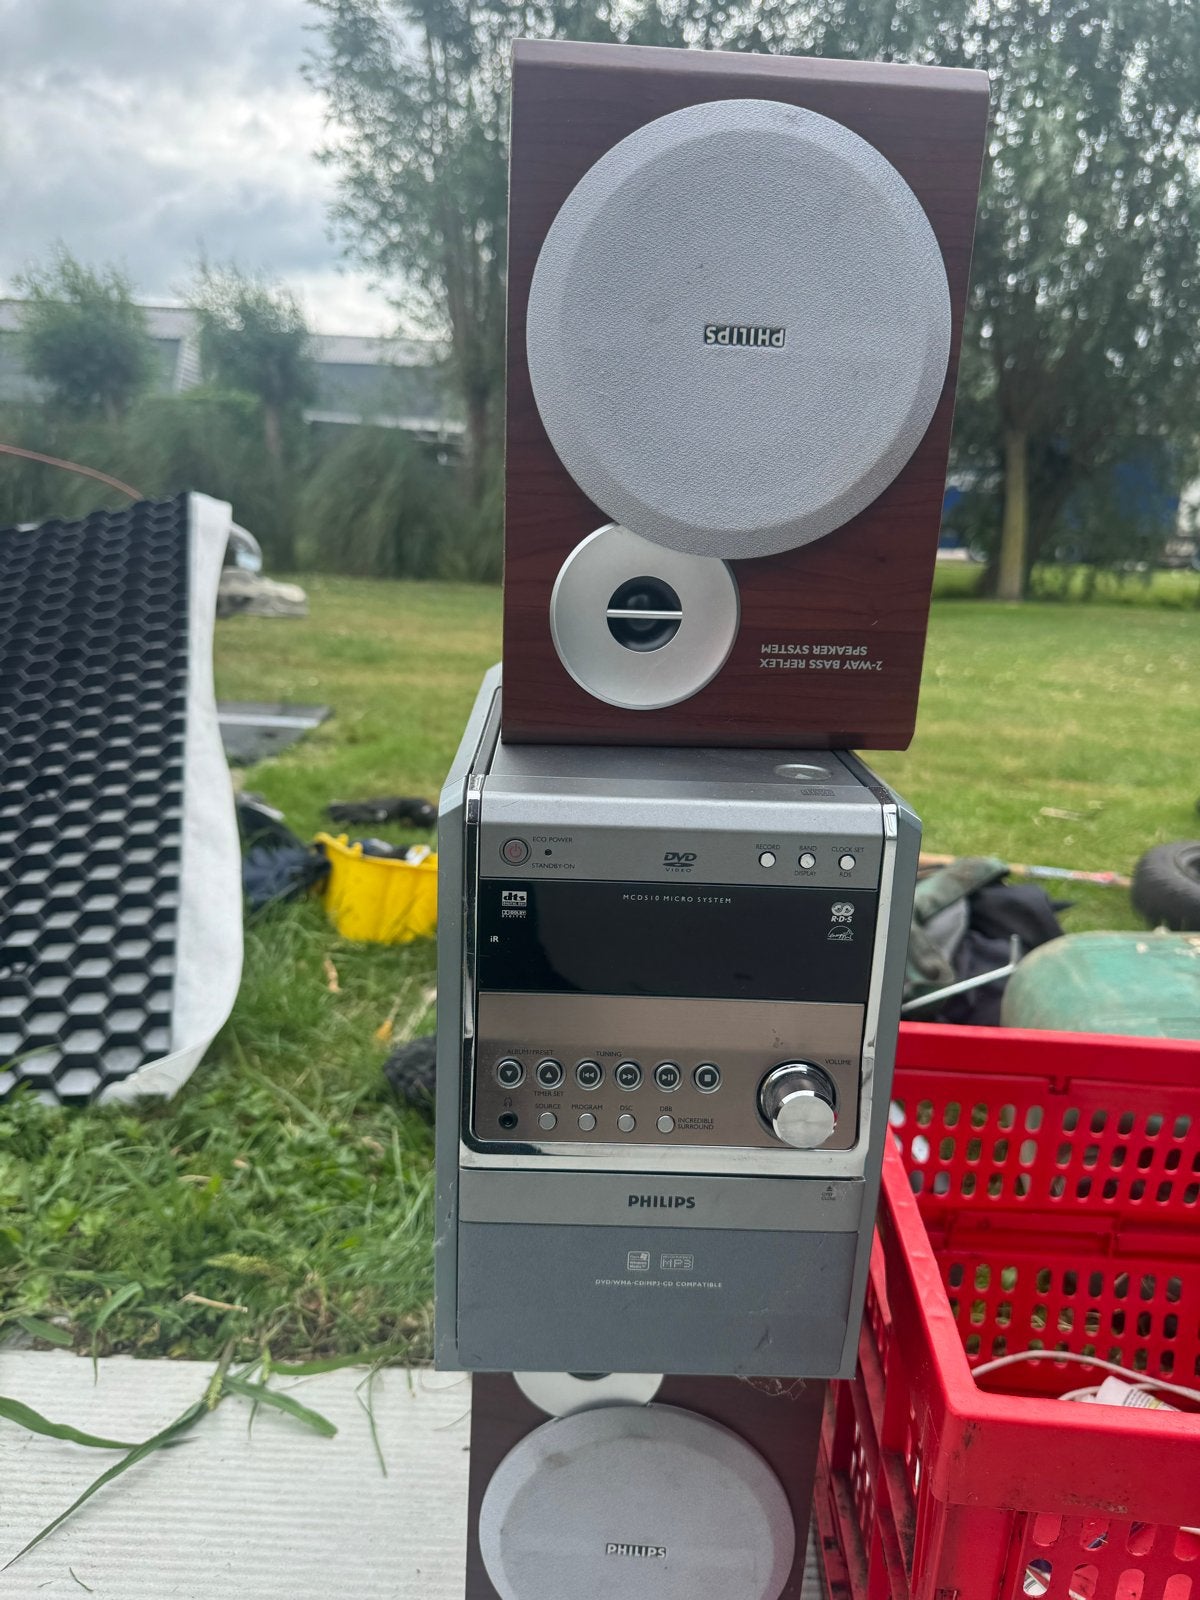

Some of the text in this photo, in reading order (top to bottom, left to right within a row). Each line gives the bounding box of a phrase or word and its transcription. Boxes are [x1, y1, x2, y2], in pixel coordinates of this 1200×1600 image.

[705, 326, 784, 347] PHILIPS
[761, 644, 868, 656] SPEAKER SYSTEM
[760, 658, 883, 670] 2-WAY BASS REFLEX
[664, 852, 698, 861] DVD
[503, 892, 526, 901] dts
[628, 1195, 696, 1209] PHILIPS
[662, 1258, 692, 1268] MP3
[675, 1281, 723, 1289] COMPATIBLE
[606, 1543, 666, 1559] PHILIPS
